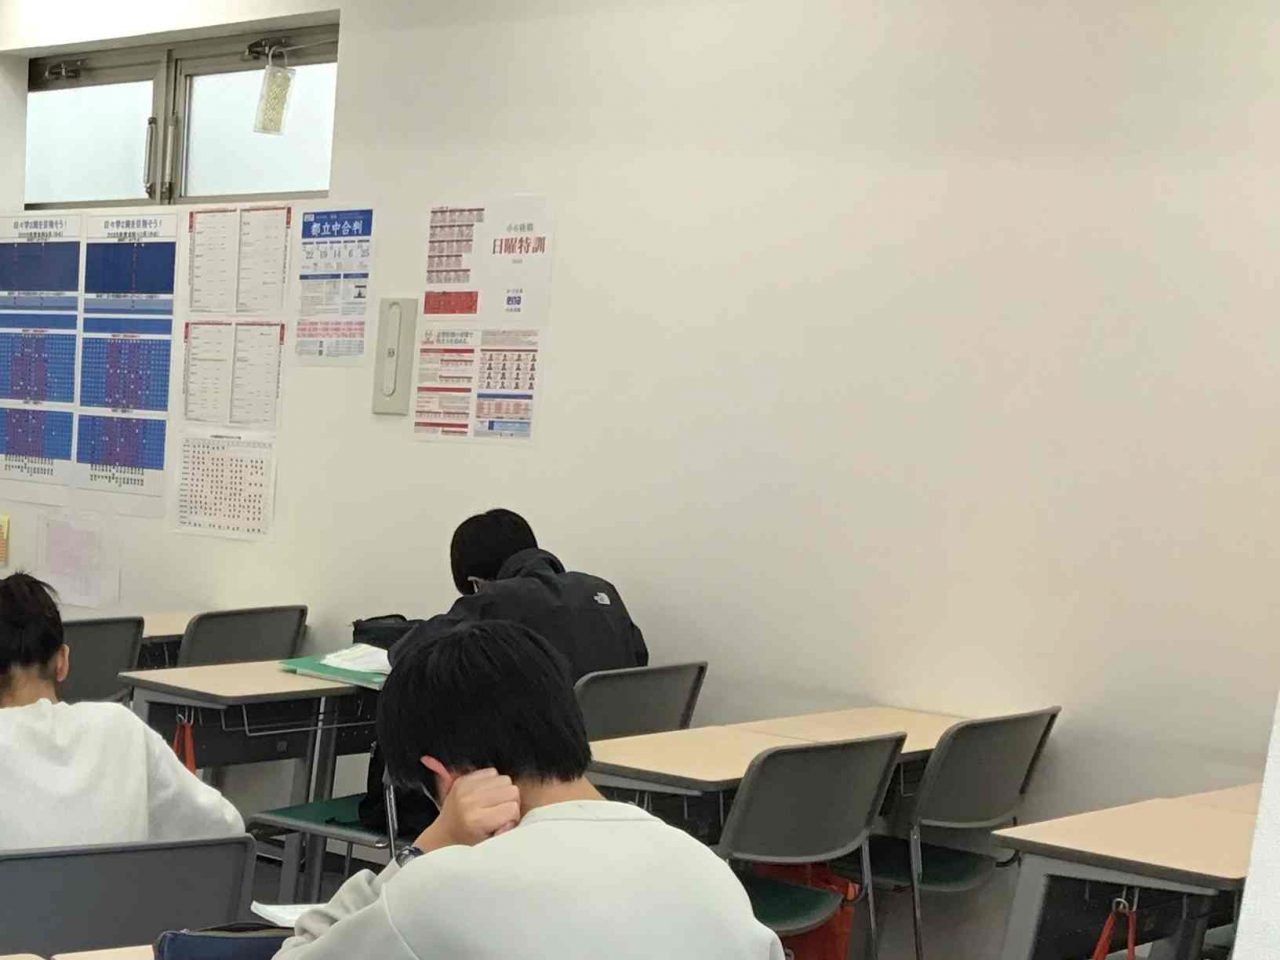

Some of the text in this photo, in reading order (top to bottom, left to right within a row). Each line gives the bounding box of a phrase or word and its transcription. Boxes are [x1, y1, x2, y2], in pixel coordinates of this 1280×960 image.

[311, 220, 363, 237] 都立中合判
[492, 237, 546, 254] 日曜特訓
